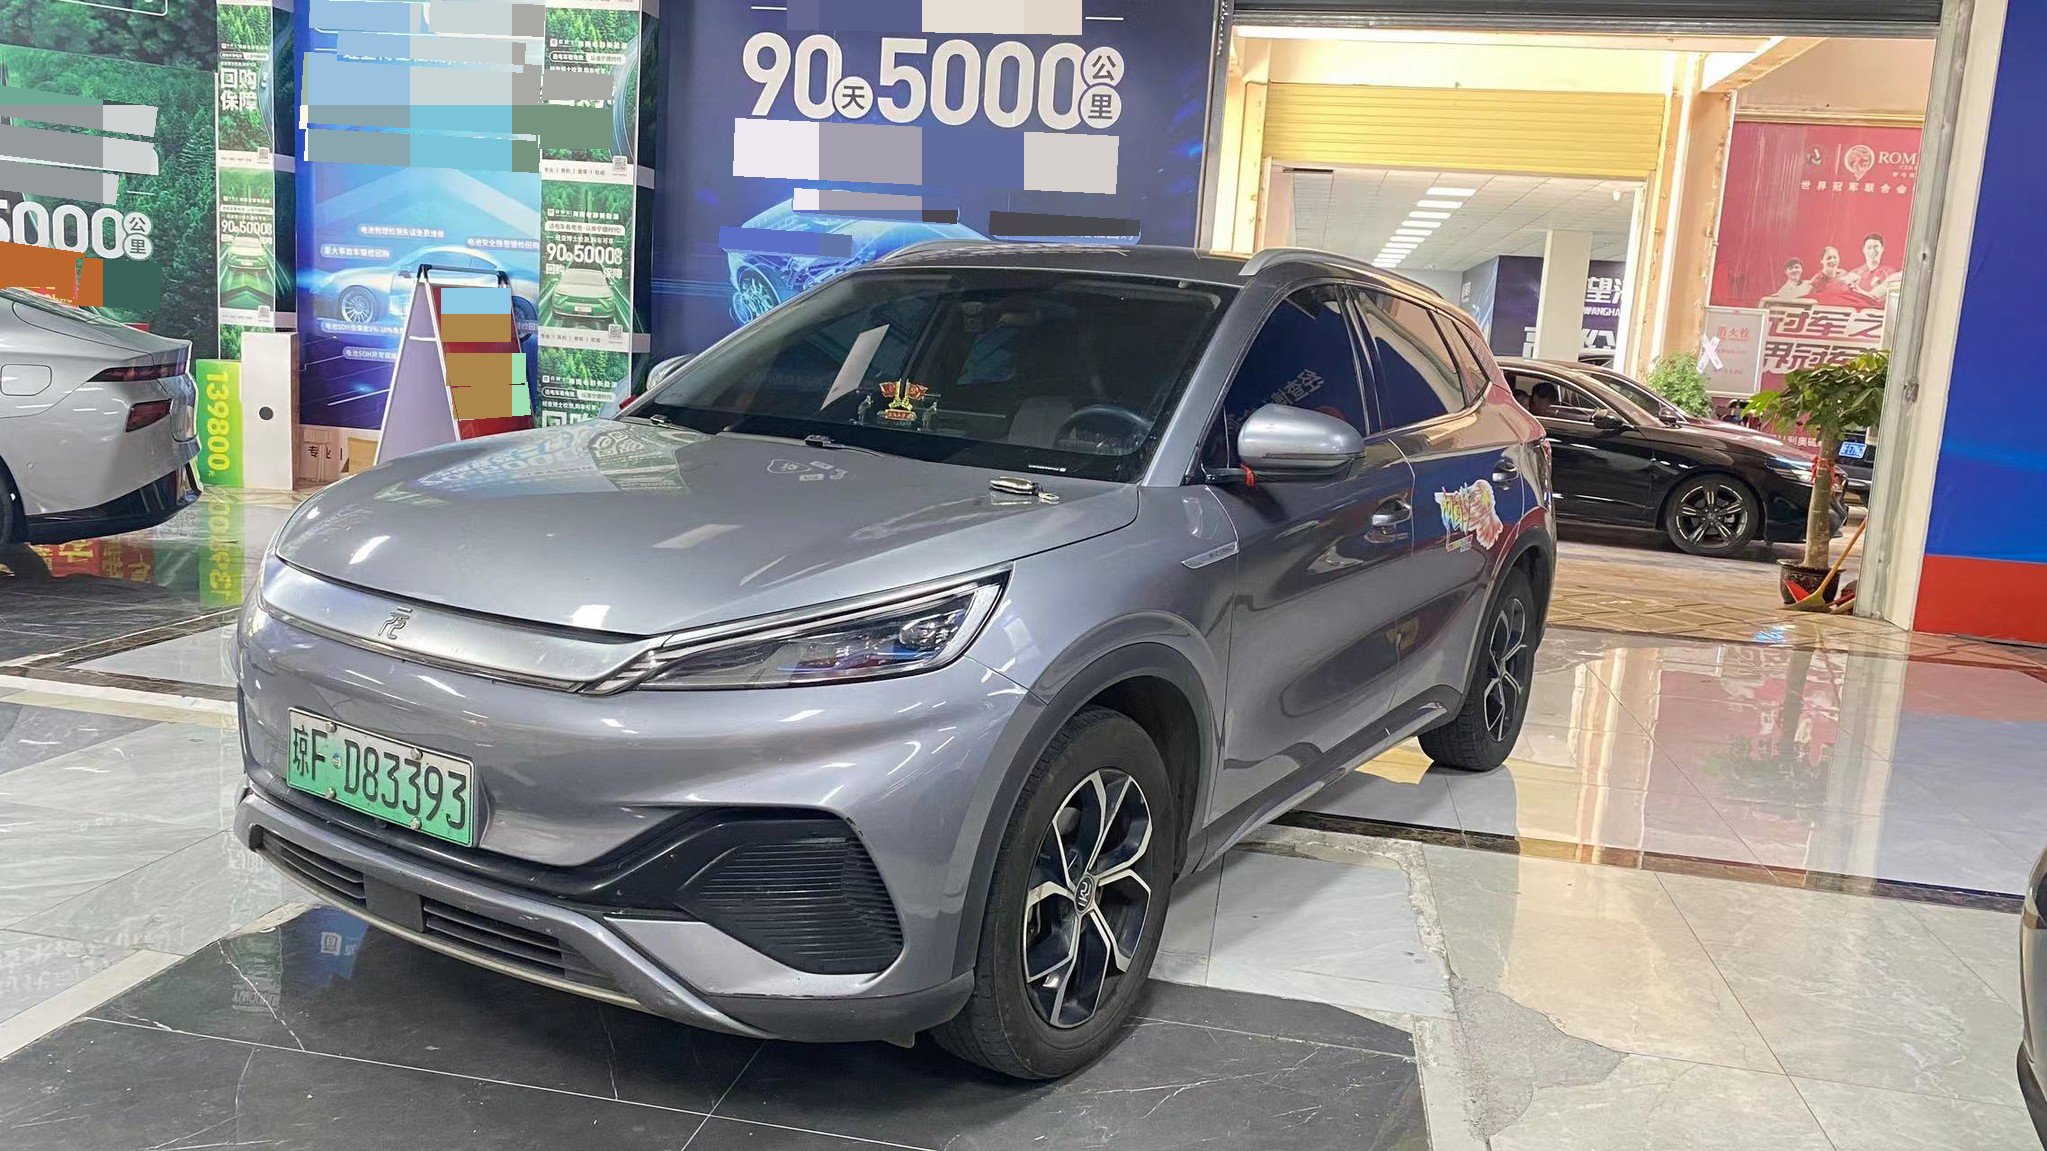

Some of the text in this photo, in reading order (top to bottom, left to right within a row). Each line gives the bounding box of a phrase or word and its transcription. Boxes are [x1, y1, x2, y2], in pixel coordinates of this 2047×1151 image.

[220, 90, 257, 111] 保障
[221, 69, 256, 89] 回购
[742, 32, 1124, 130] 90天5000公里
[0, 200, 152, 261] 000公里
[206, 371, 230, 471] 139800
